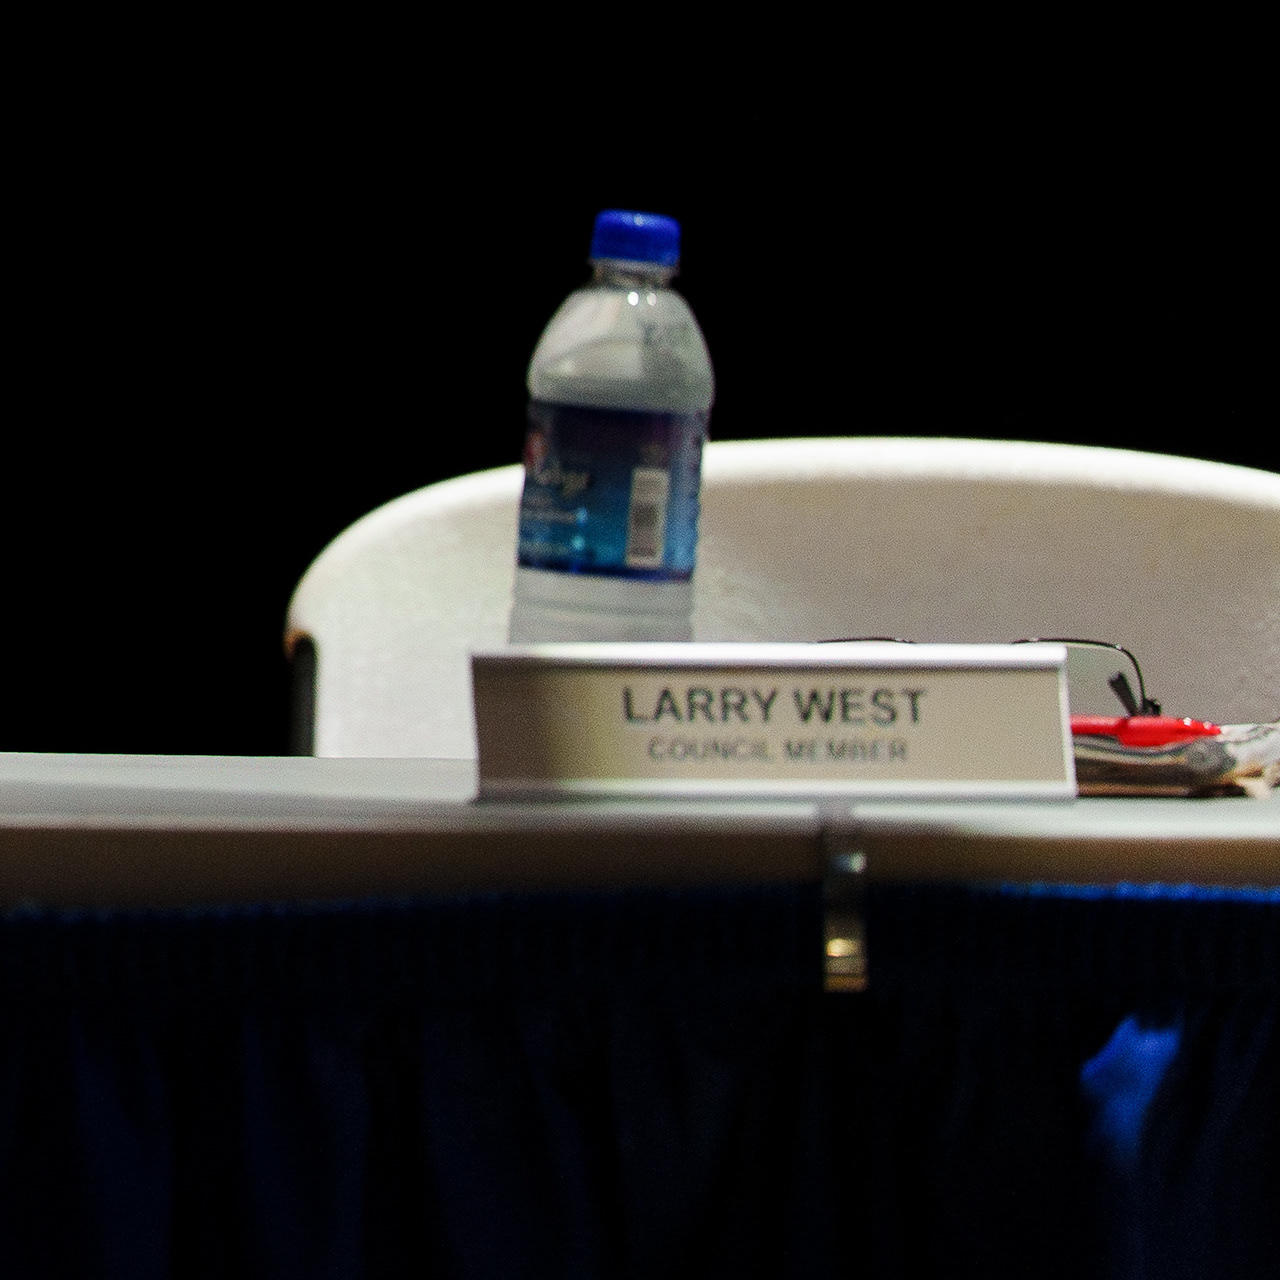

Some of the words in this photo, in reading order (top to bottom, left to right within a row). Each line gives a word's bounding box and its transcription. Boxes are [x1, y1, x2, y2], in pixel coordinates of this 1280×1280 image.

[622, 684, 779, 724] LARRY
[793, 685, 927, 726] WEST
[647, 734, 774, 762] COUNCIL
[784, 737, 908, 764] MEMBER
